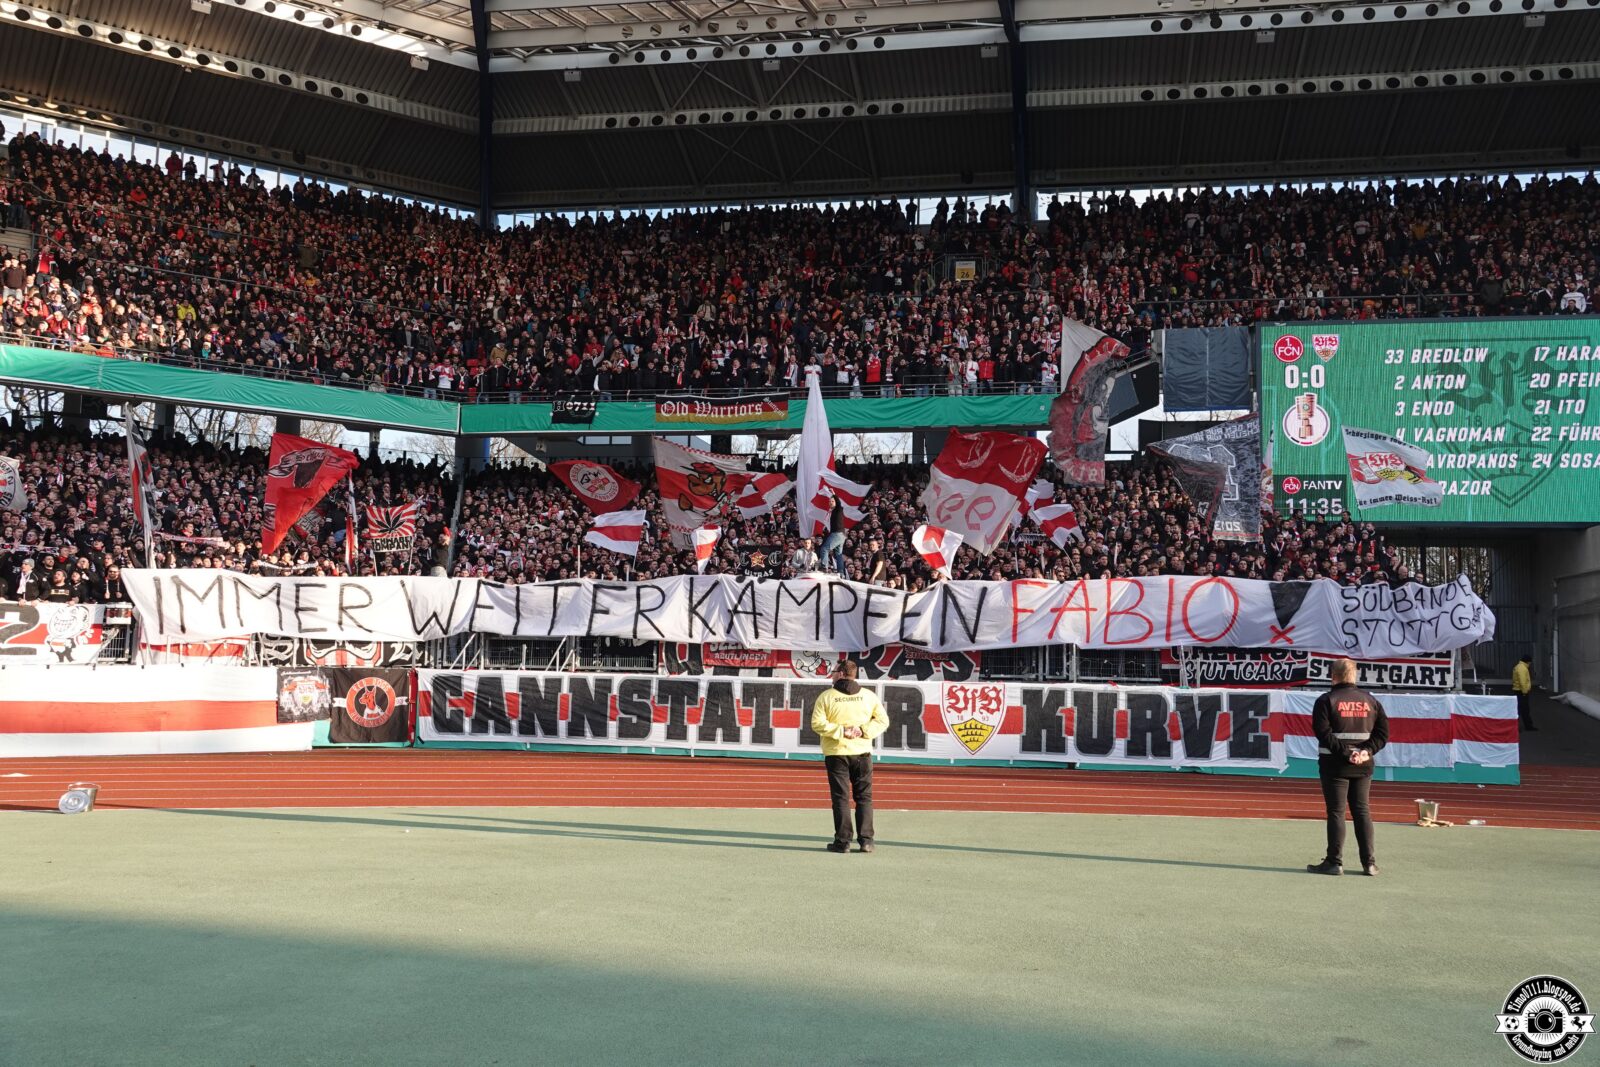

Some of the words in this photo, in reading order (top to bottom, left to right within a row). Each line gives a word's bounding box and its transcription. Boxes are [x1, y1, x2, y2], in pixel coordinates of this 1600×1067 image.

[1277, 346, 1300, 357] FCN
[1384, 349, 1405, 364] 33
[1411, 347, 1489, 364] BREDLOW
[1534, 346, 1551, 361] 17
[1284, 364, 1325, 389] 0:0
[1394, 375, 1406, 390] 2
[1411, 374, 1467, 390] ANTON
[1529, 373, 1551, 388] 20
[661, 400, 689, 417] Old
[694, 401, 764, 419] Warriors
[1395, 401, 1406, 416] 3
[1411, 400, 1455, 416] ENDO
[1534, 400, 1551, 415] 21
[1557, 399, 1586, 415] ITO
[1395, 427, 1406, 442] 4
[1414, 426, 1506, 443] VAGNOMAN
[1531, 426, 1552, 442] 22
[1558, 422, 1600, 442] FÜHR
[1426, 453, 1519, 469] AVROPANOS
[1532, 453, 1553, 468] 24
[1303, 480, 1343, 490] FANTV
[1438, 480, 1492, 496] RAZOR
[1285, 498, 1343, 515] 11:35
[744, 568, 774, 579] ULTRAS
[152, 574, 374, 635] IMMER
[1011, 576, 1240, 646] FABIO
[1184, 660, 1297, 681] STUTTGART
[1309, 660, 1452, 686] STTTGART
[834, 695, 864, 703] SECURITY
[946, 684, 1003, 717] VfB
[1337, 701, 1371, 712] AVISA
[1020, 688, 1272, 761] KURVE
